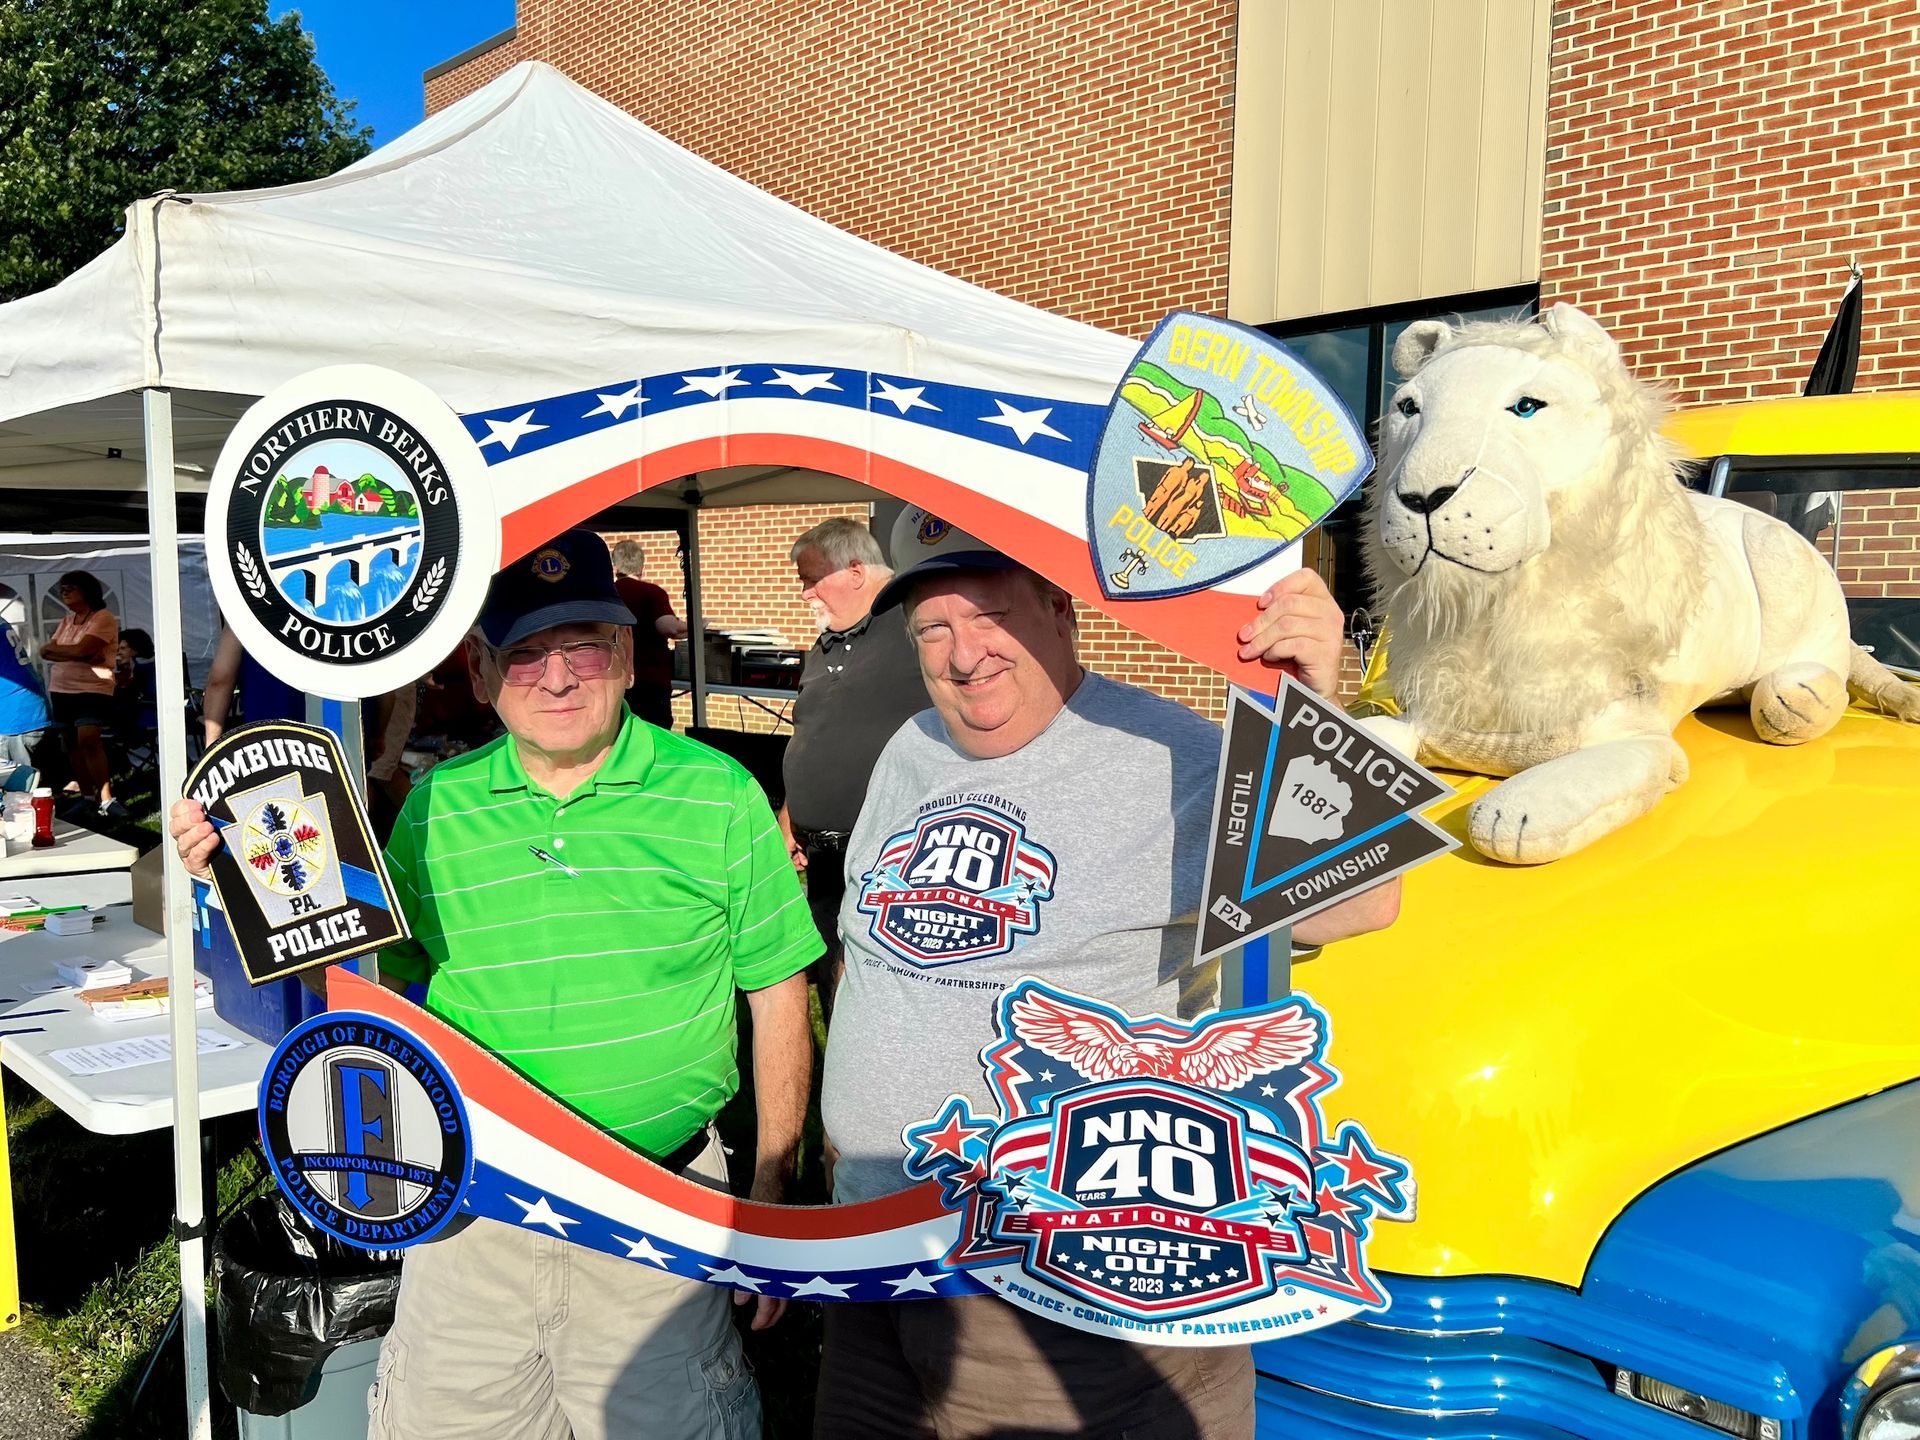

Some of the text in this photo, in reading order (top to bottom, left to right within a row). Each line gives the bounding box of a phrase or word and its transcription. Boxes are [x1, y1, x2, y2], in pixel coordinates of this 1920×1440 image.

[1167, 324, 1358, 477] BERN TOWNSHIP
[238, 407, 449, 506] NORTHERN BERKS
[1108, 503, 1198, 579] POLICE
[278, 612, 396, 659] POLICE
[1287, 703, 1421, 806] POLICE
[192, 738, 333, 813] HAMBURG
[919, 793, 1028, 822] PROUDLY CELEBRATING
[1226, 771, 1254, 847] TILDEN
[1291, 782, 1341, 821] 1887
[922, 824, 1001, 856] NNO
[910, 847, 995, 891] 40
[1280, 843, 1391, 906] TOWNSHIP
[893, 890, 1000, 913] NATIONAL
[903, 907, 985, 930] NIGHT
[1218, 903, 1243, 929] PA
[266, 908, 368, 963] POLICE
[913, 922, 969, 940] OUT
[920, 937, 943, 950] 2023
[934, 977, 1006, 991] PARTNERSHIPS
[270, 1026, 458, 1134] BOROUGH OF FLEETWOOD
[1081, 1109, 1217, 1154] NNO
[303, 1155, 434, 1184] INCORPORATED 1873
[1075, 1143, 1218, 1208] 40
[280, 1156, 457, 1239] POLICE DEPARTMENT
[1075, 1191, 1107, 1201] YEARS
[1061, 1210, 1240, 1237] NATIONAL
[1082, 1235, 1221, 1261] NIGHT
[1105, 1254, 1197, 1277] OUT
[1128, 1276, 1164, 1295] 2023
[1006, 1281, 1065, 1313] POLICE
[1181, 1308, 1314, 1336] PARTNERSHIPS
